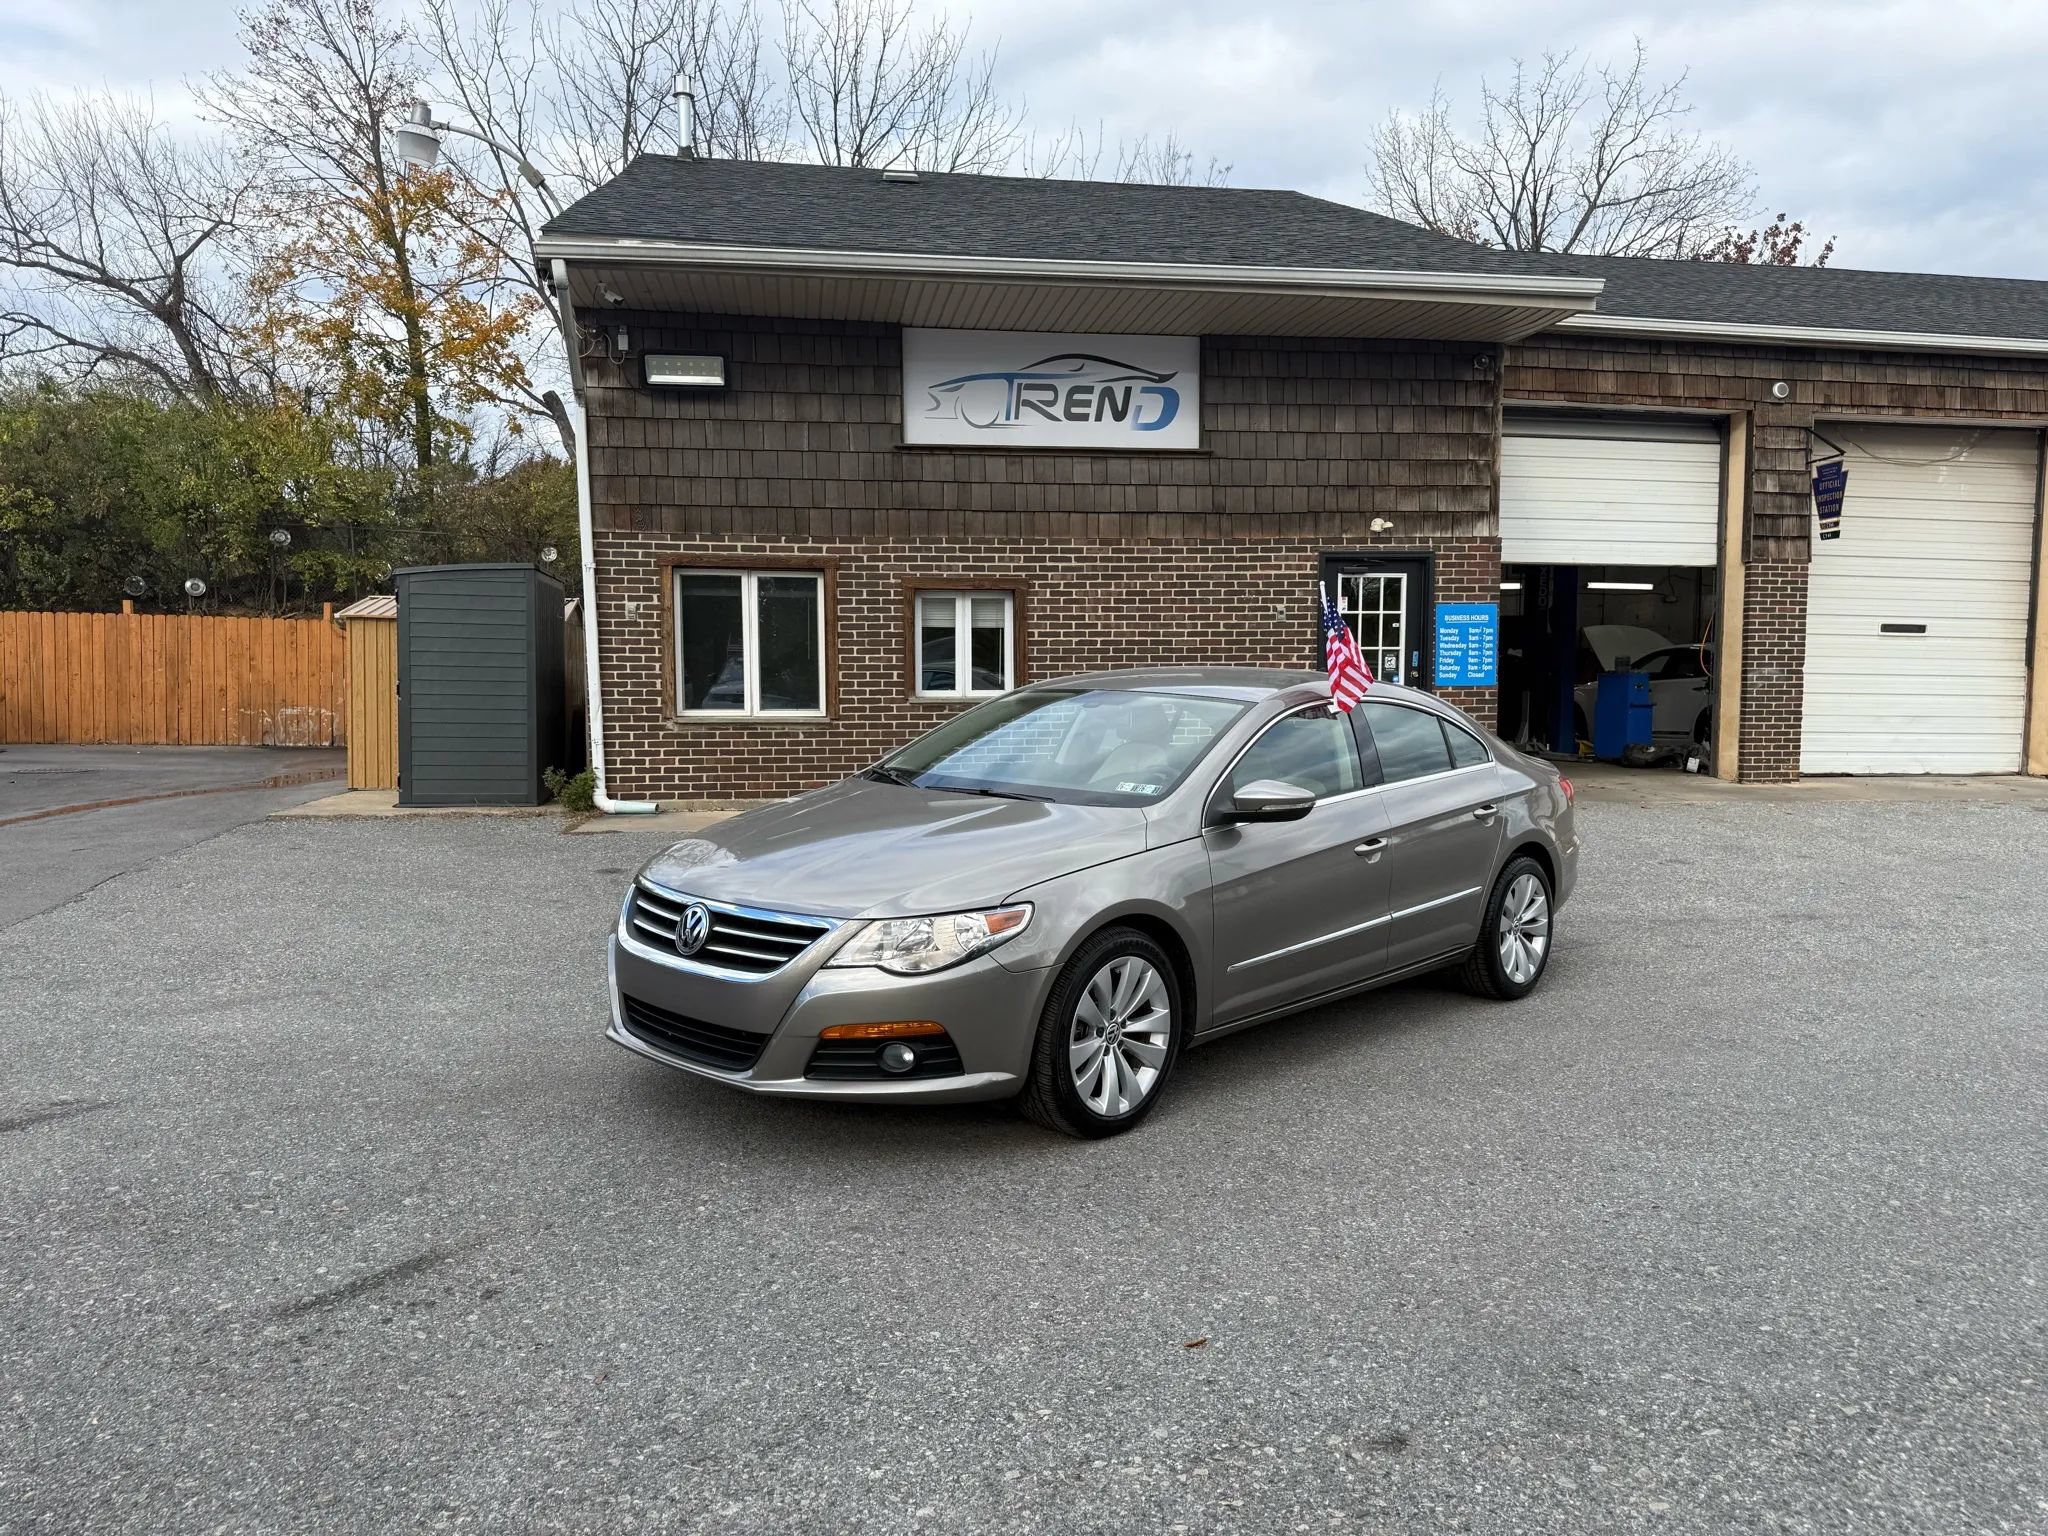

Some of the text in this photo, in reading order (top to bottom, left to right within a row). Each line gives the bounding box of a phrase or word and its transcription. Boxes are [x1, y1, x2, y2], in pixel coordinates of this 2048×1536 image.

[1002, 372, 1180, 431] TREND
[1819, 480, 1840, 490] OFFICIAL
[1816, 491, 1843, 503] INSPECTION
[1820, 503, 1840, 513] STATION
[1440, 627, 1459, 635] Monday
[1440, 642, 1467, 650] Wednesday
[1440, 649, 1462, 657] Thursday
[1439, 657, 1455, 665] Friday
[1439, 664, 1460, 672] Saturday
[1439, 671, 1457, 679] Sunday
